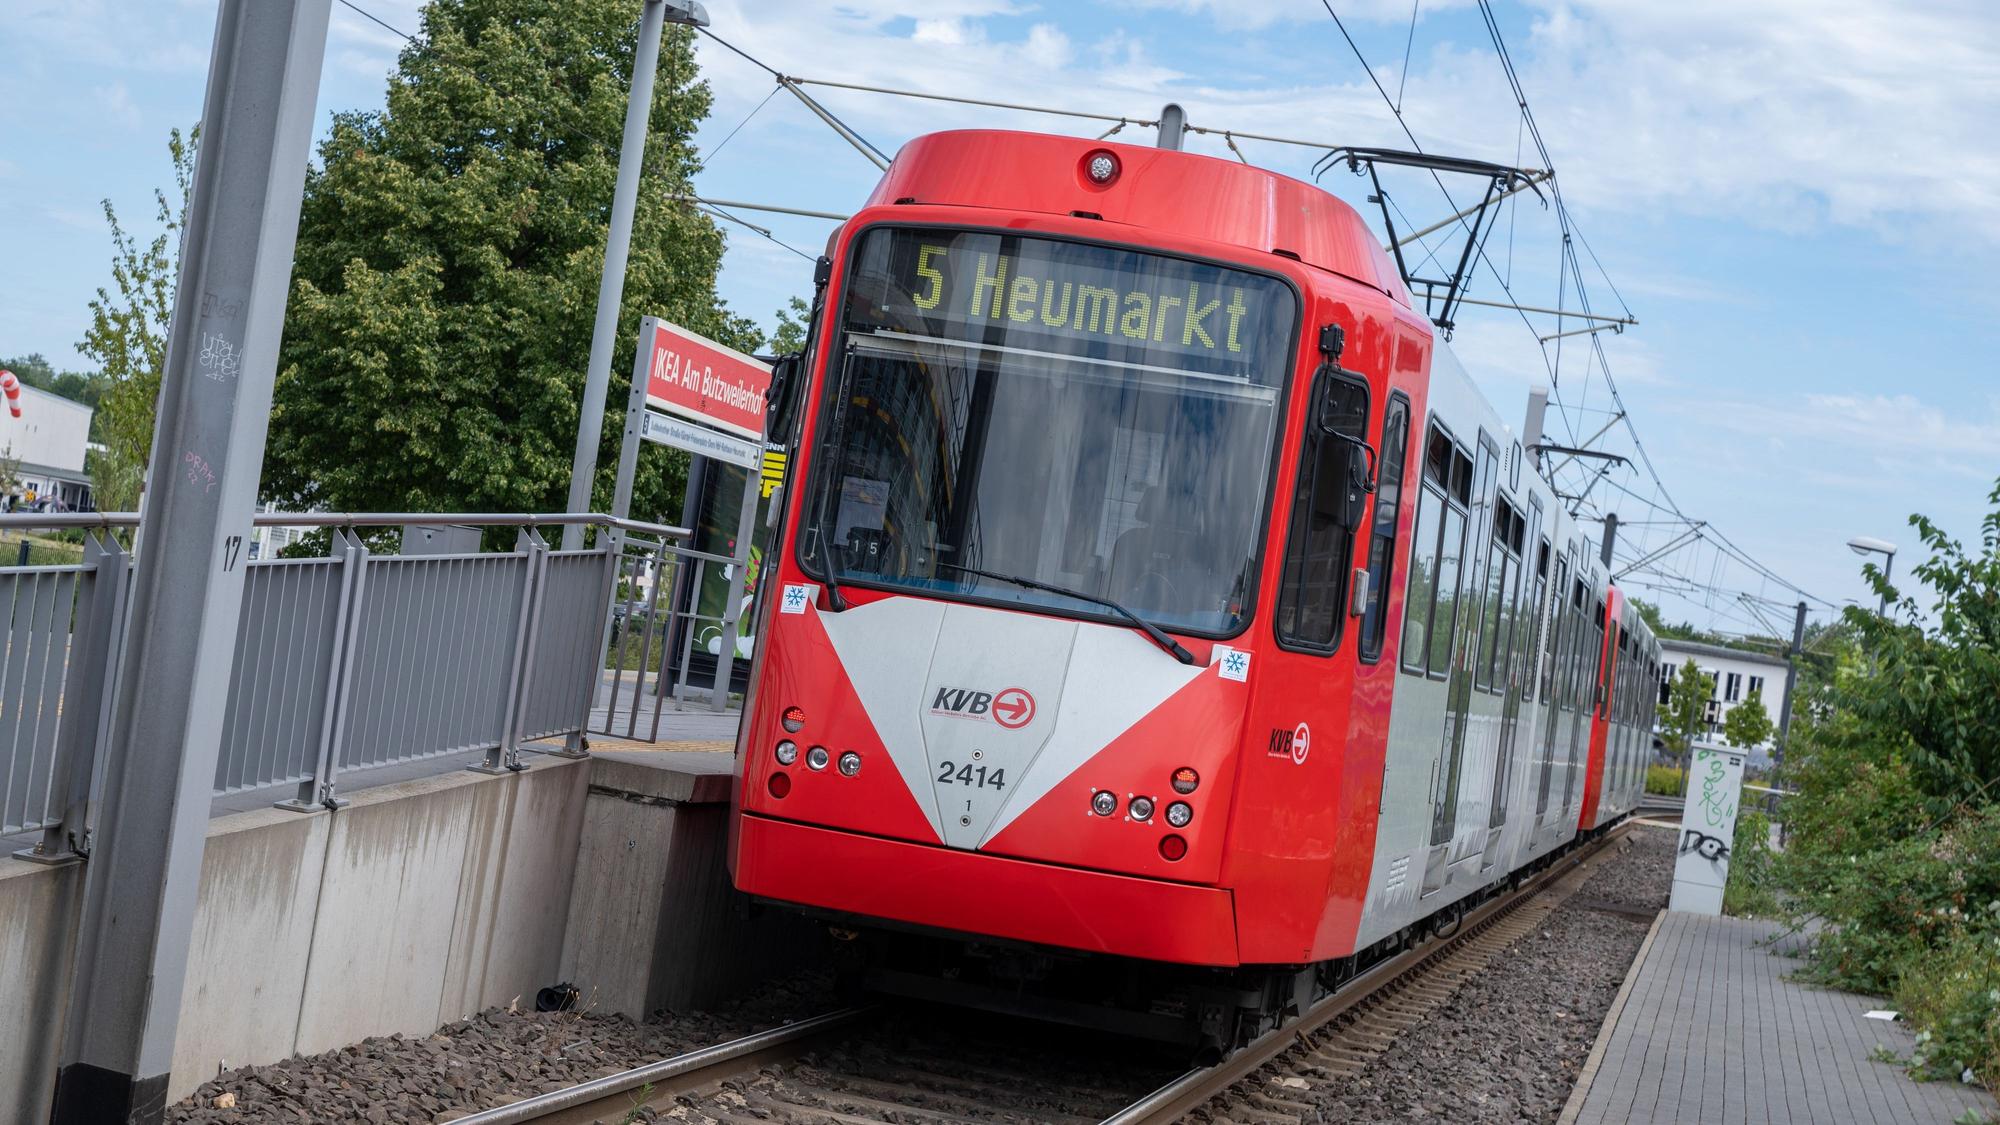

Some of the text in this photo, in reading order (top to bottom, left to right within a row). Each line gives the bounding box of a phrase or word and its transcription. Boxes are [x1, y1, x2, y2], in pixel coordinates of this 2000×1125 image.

[913, 244, 1247, 352] 5 Heumarkt
[654, 347, 765, 415] IKEA Am Butzweilerhof
[224, 535, 242, 572] 17
[932, 687, 992, 715] KVB
[1703, 701, 1720, 722] H
[1269, 728, 1293, 753] KVB
[937, 760, 1006, 791] 2414
[966, 799, 971, 812] 1
